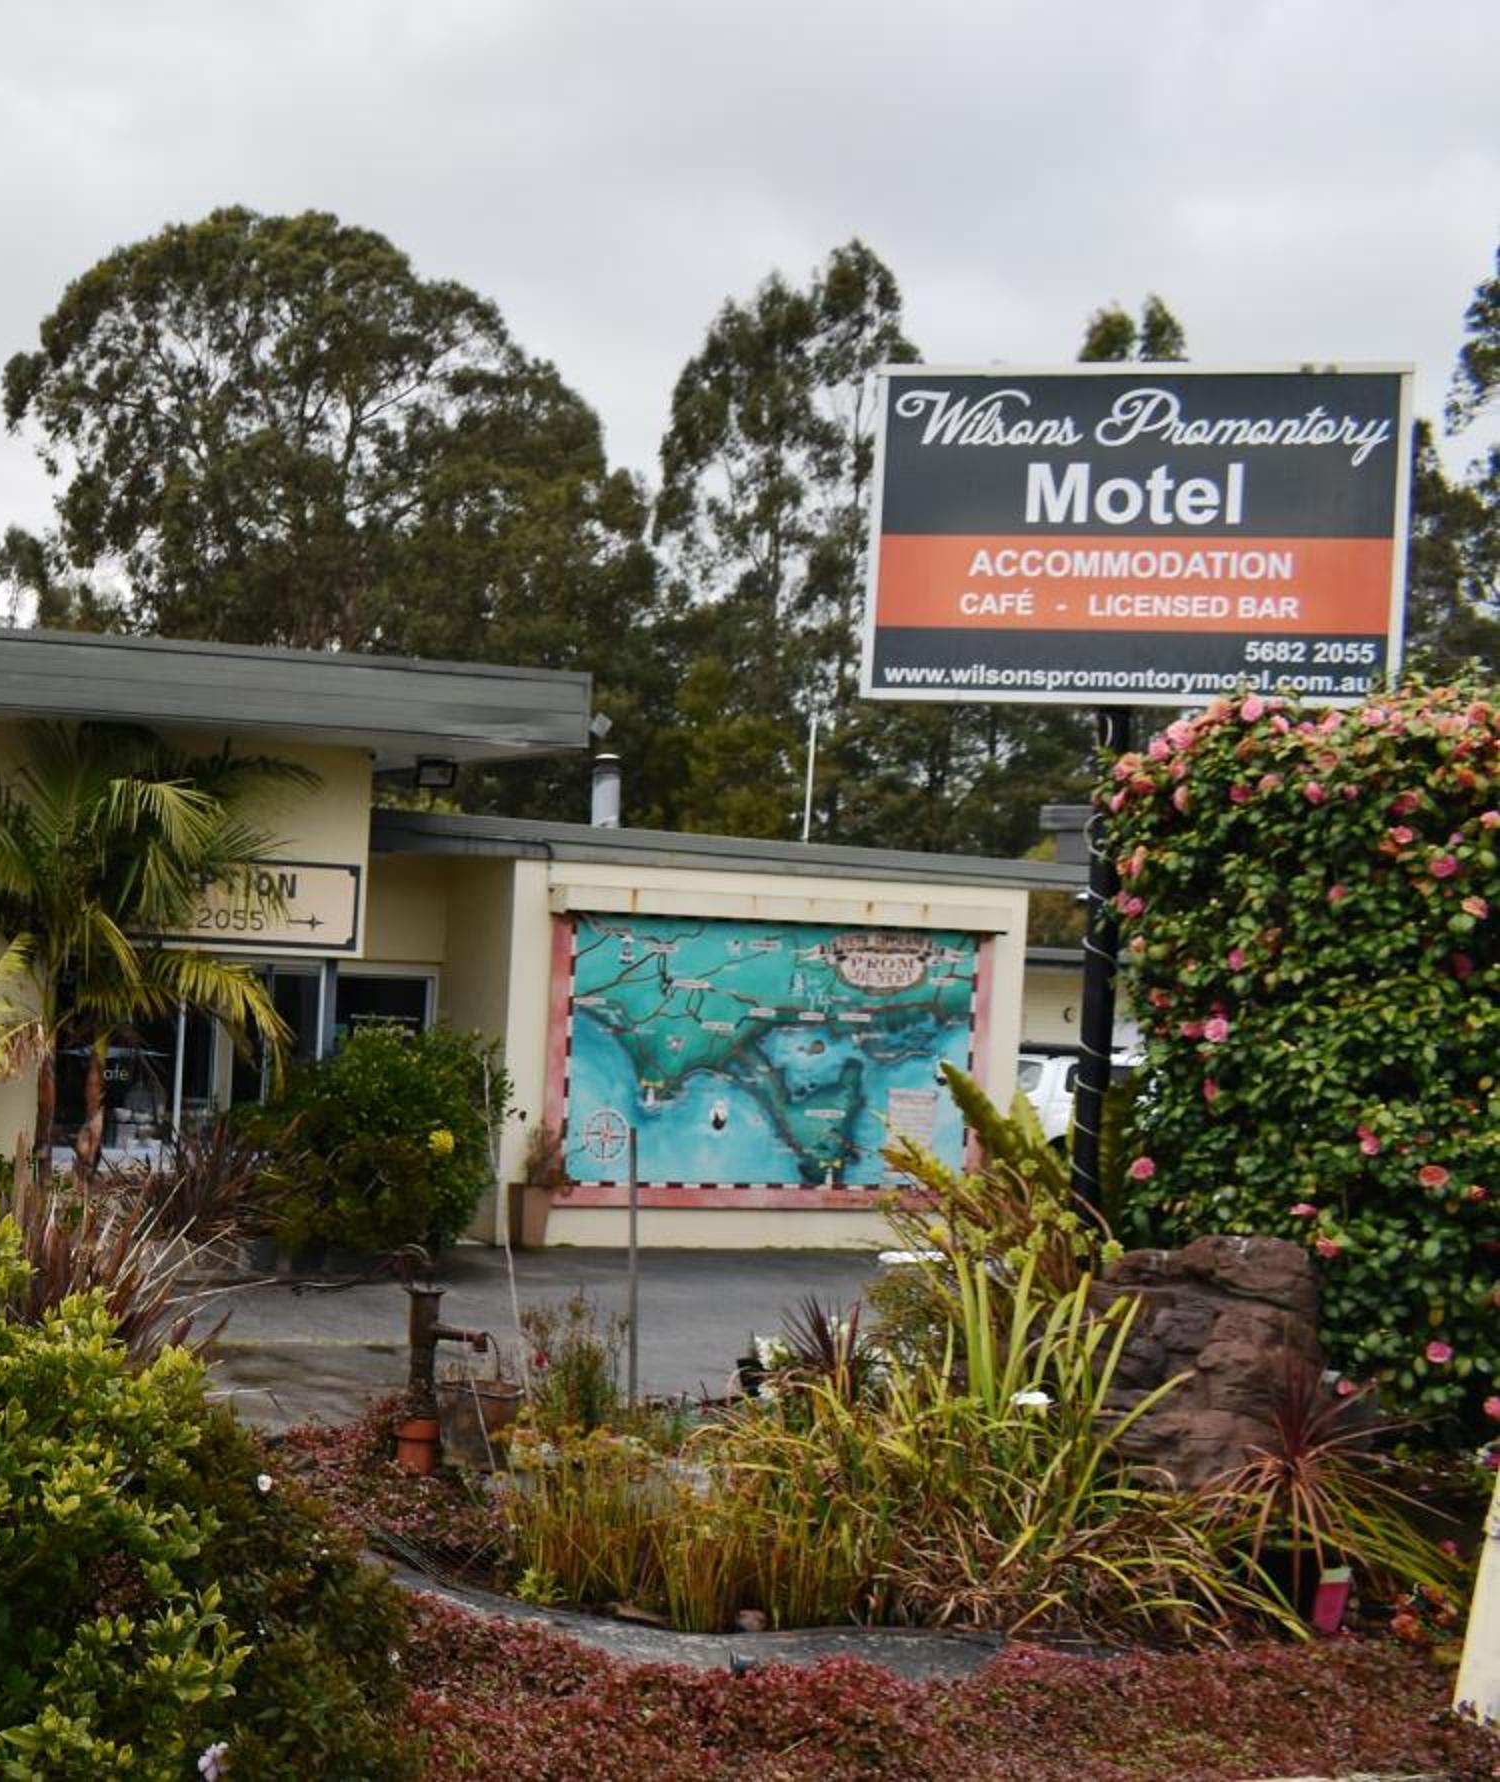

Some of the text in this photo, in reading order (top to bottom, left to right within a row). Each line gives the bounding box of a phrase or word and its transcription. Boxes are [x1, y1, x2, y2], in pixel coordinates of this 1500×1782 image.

[895, 388, 1390, 467] Wilsons Promontory
[1025, 462, 1245, 525] Motel
[968, 550, 1293, 580] ACCOMMODATION
[959, 589, 1034, 616] CAFÉ
[1088, 597, 1227, 618] LICENSED
[1237, 598, 1299, 620] BAR
[1244, 640, 1376, 664] 5682 2055
[884, 665, 1374, 693] www.wilsonspromontorymotel.com.au
[197, 907, 264, 931] 2055
